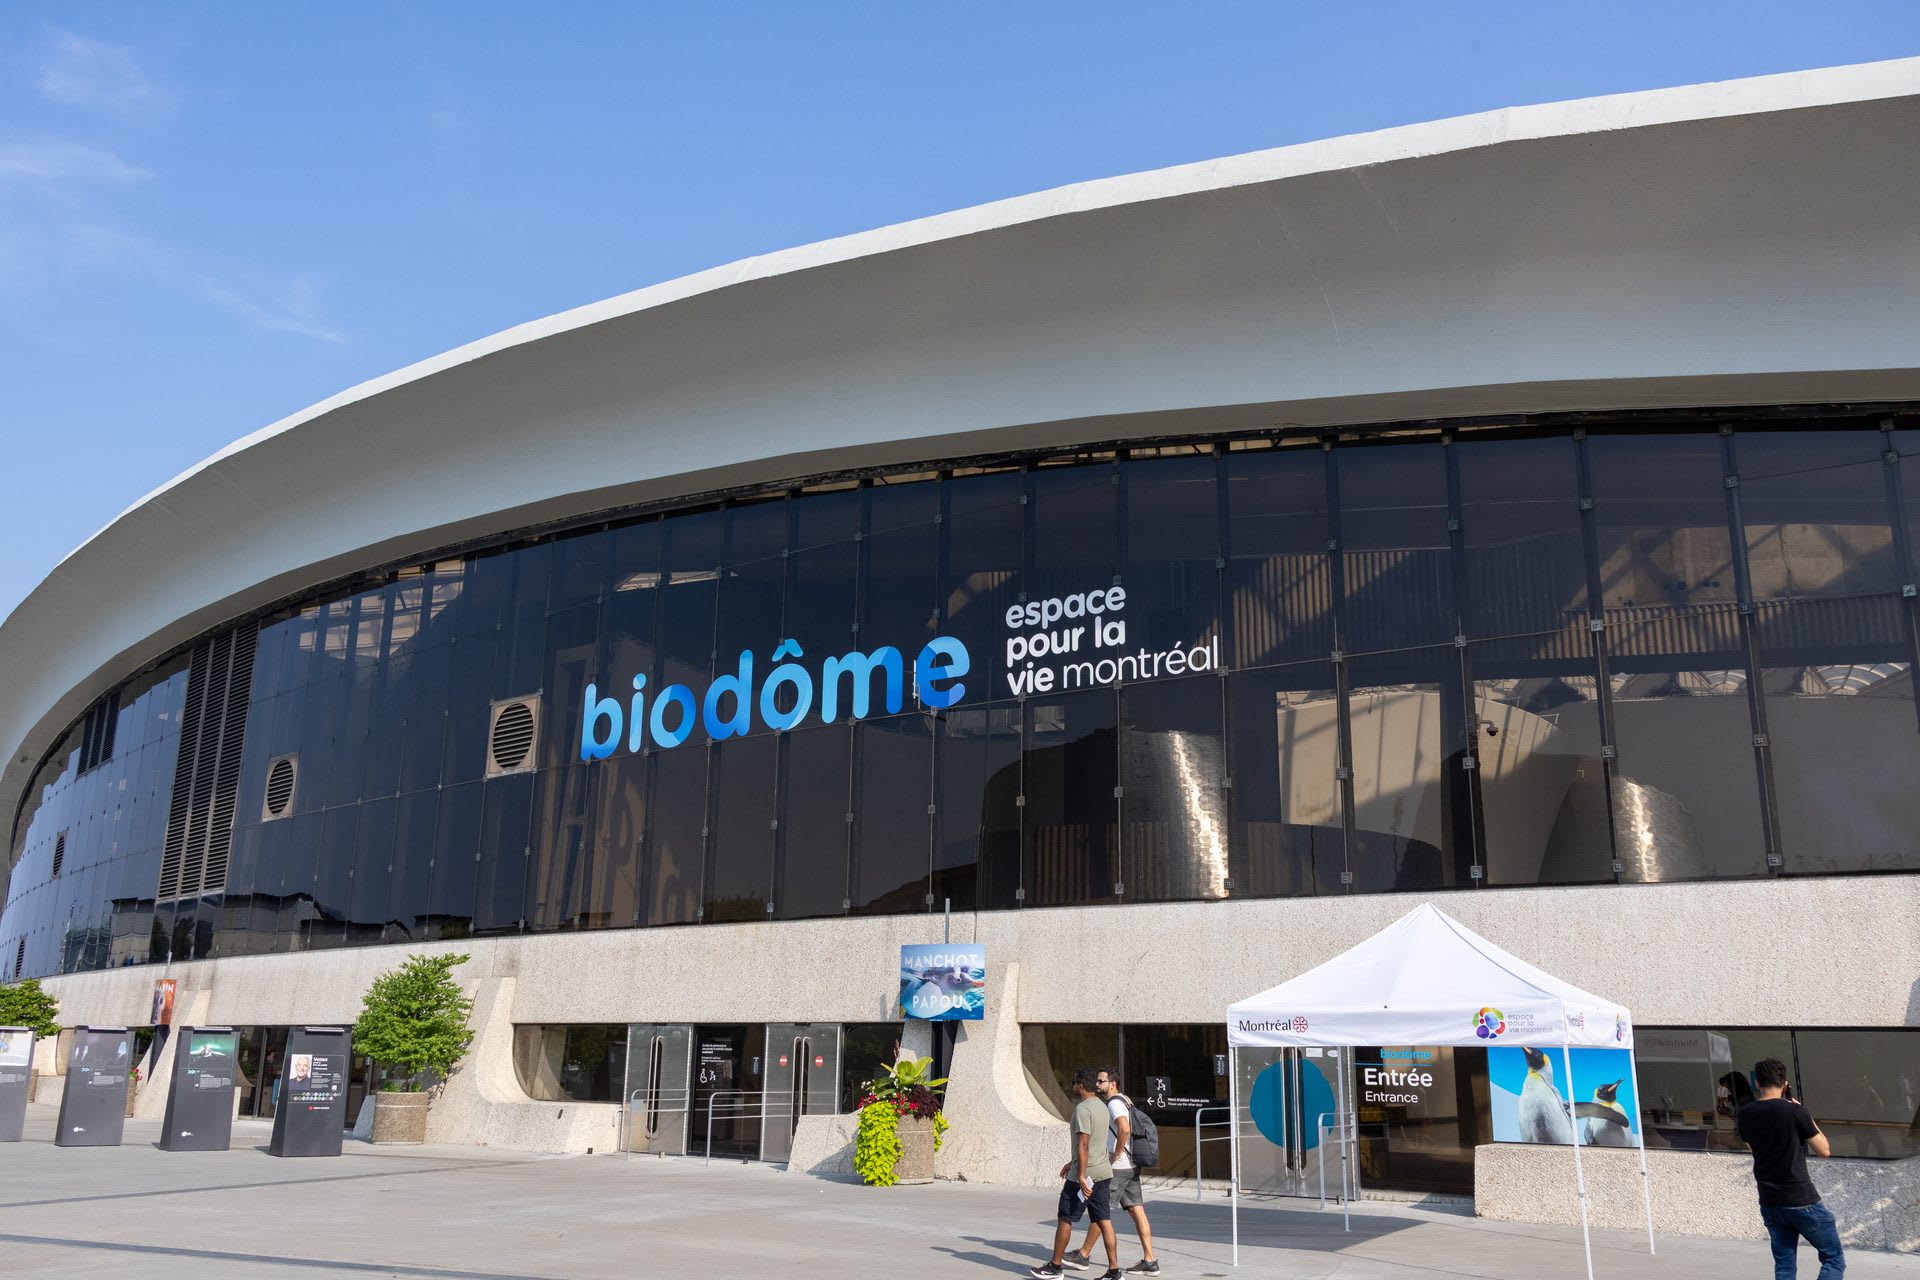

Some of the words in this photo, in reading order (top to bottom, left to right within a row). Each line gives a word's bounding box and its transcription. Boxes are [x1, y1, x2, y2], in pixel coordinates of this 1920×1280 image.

[1005, 586, 1126, 629] espace
[1006, 626, 1085, 668] pour
[1095, 616, 1126, 648] la
[1006, 662, 1055, 696] vie
[1063, 635, 1219, 689] montréal
[581, 636, 970, 760] biodôme
[904, 954, 978, 968] MANCHOT
[912, 994, 963, 1009] PAPOU
[1239, 1019, 1291, 1031] Montréal
[1380, 1048, 1432, 1060] biodôme
[1364, 1068, 1433, 1087] Entrée
[1365, 1090, 1418, 1103] Entrance
